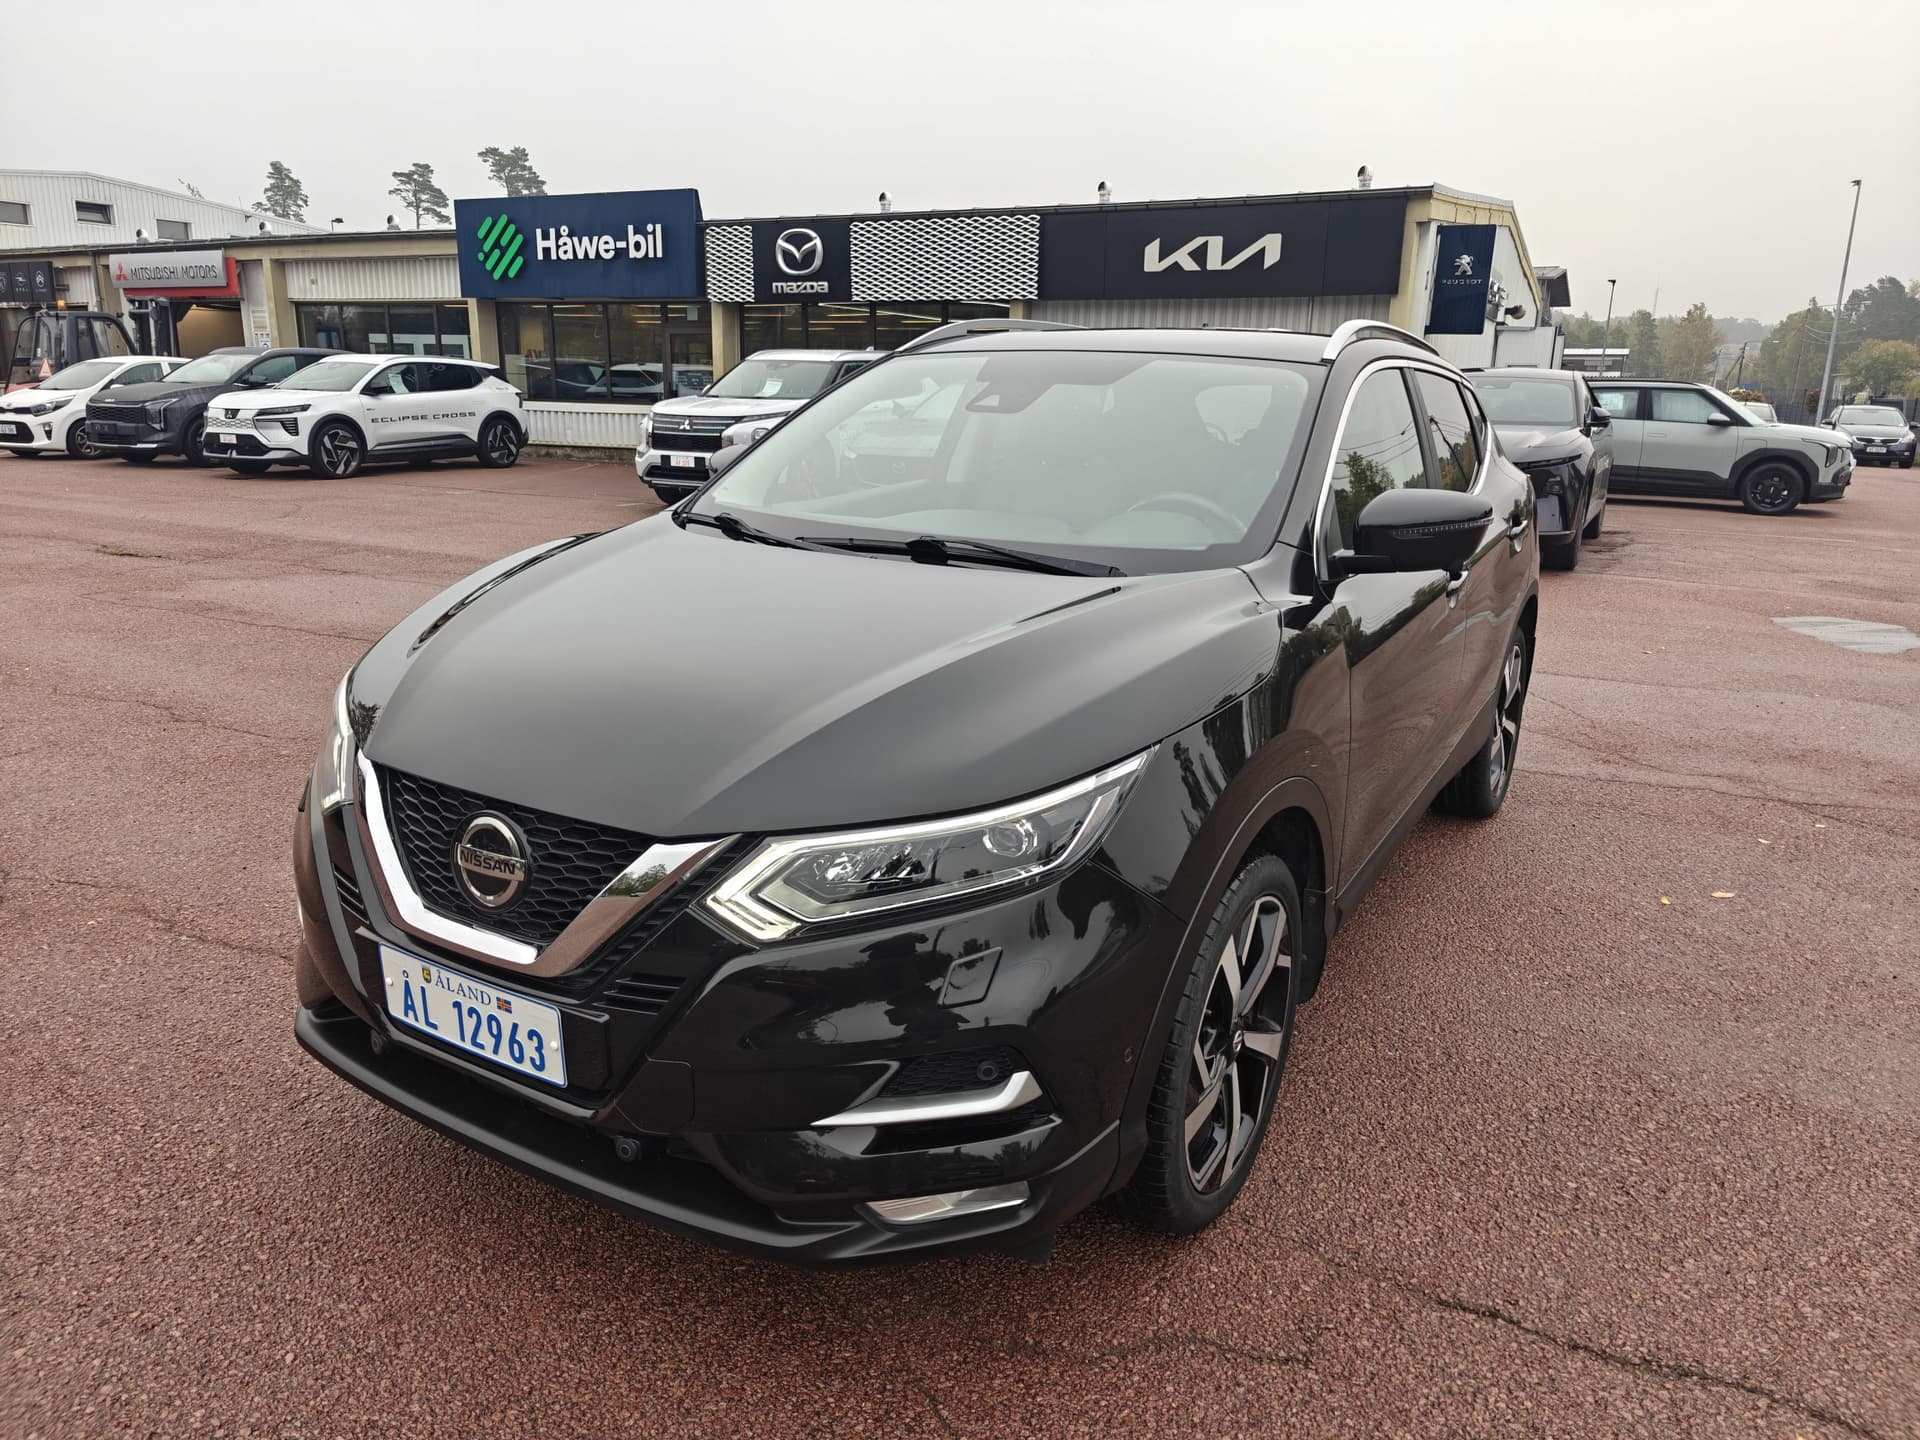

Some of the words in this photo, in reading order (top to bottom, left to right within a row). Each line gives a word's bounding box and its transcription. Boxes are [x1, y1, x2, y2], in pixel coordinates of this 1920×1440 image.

[535, 223, 663, 260] Håwe-bil
[1143, 233, 1282, 272] KIA
[130, 265, 179, 281] MITSUBISHI
[181, 264, 218, 280] MOTORS
[772, 281, 829, 294] mazda
[371, 414, 428, 424] ECLIPSE
[432, 411, 477, 420] CROSS
[460, 850, 516, 875] NISSAN
[435, 969, 491, 1006] ÅLAND
[402, 969, 438, 1031] ÅL
[452, 1000, 546, 1072] 12963
